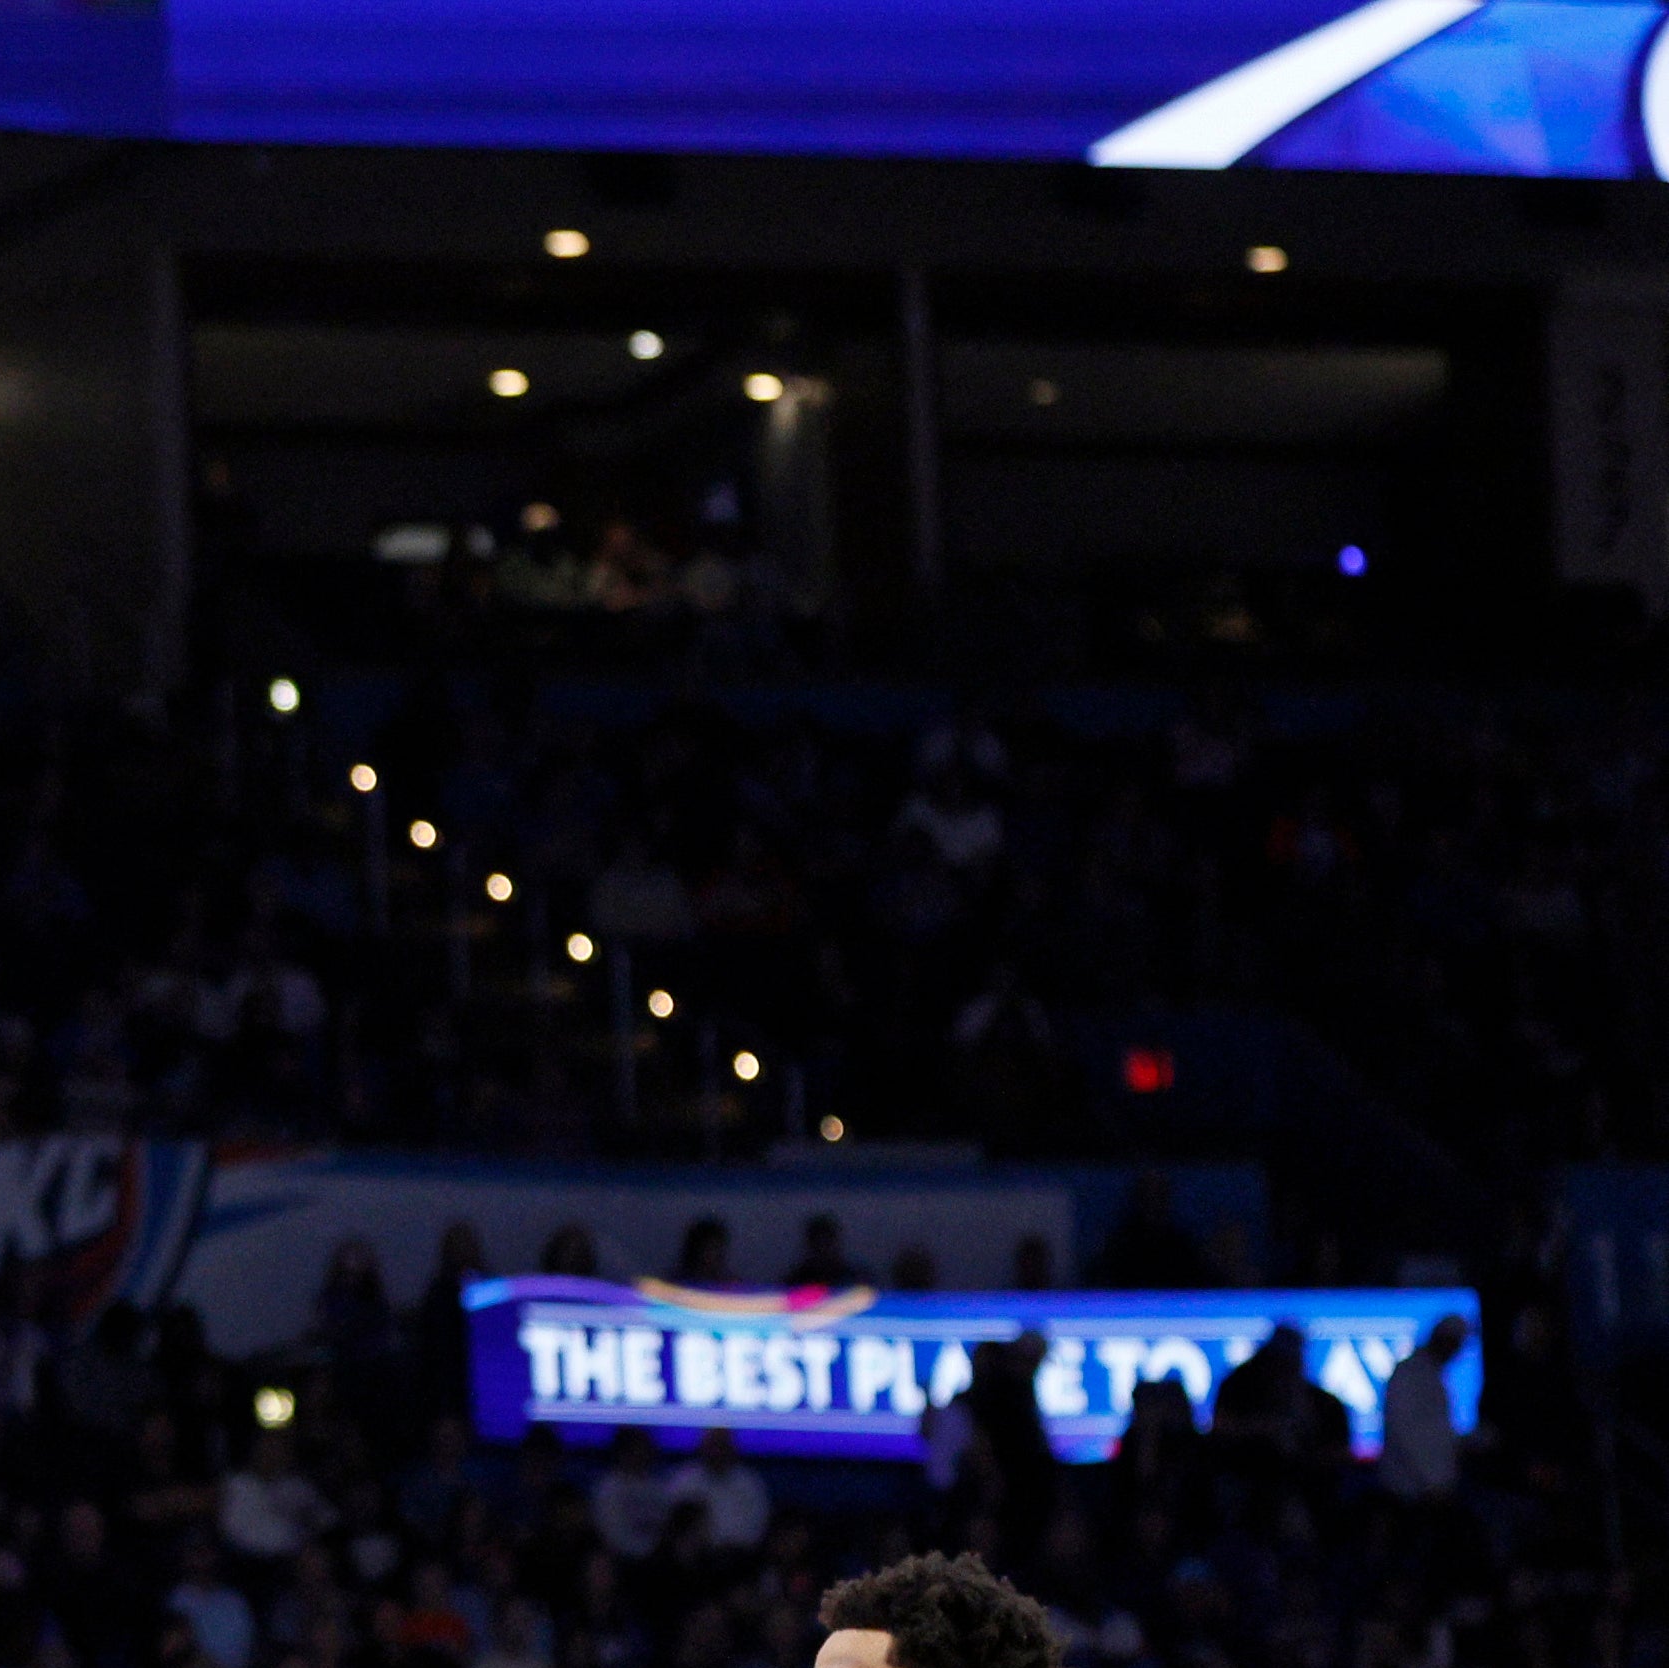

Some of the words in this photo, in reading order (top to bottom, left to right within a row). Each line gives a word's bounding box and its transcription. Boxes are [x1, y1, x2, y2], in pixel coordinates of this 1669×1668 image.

[520, 1321, 667, 1404] THE
[674, 1327, 839, 1412] BEST
[849, 1333, 1088, 1417] PLAE
